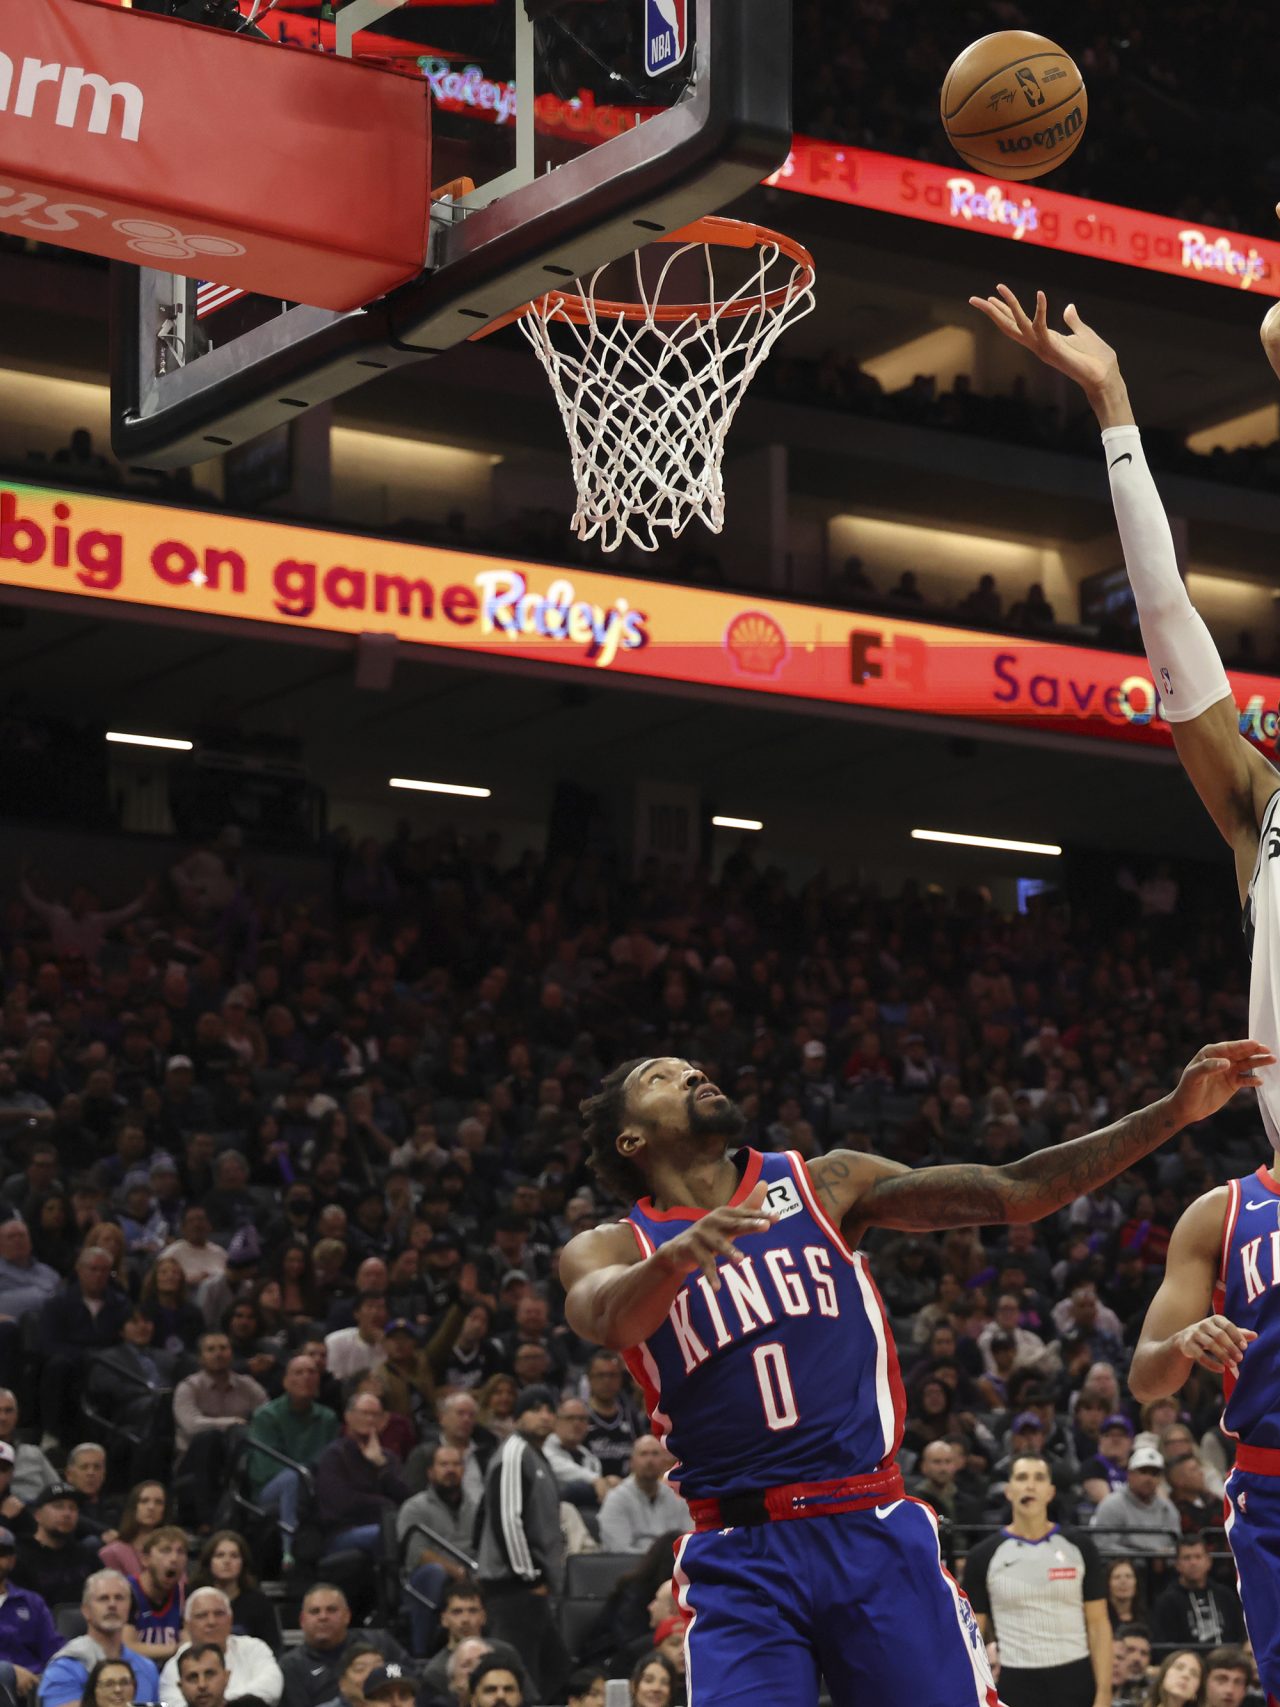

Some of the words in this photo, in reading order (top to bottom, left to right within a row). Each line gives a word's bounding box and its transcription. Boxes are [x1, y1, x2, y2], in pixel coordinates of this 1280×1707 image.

[651, 30, 671, 65] NBA
[997, 105, 1083, 153] Wilson
[0, 491, 123, 590] big
[151, 540, 246, 593] on
[272, 559, 479, 626] game
[766, 1185, 791, 1208] R
[668, 1246, 840, 1377] KINGS
[751, 1341, 800, 1432] 0
